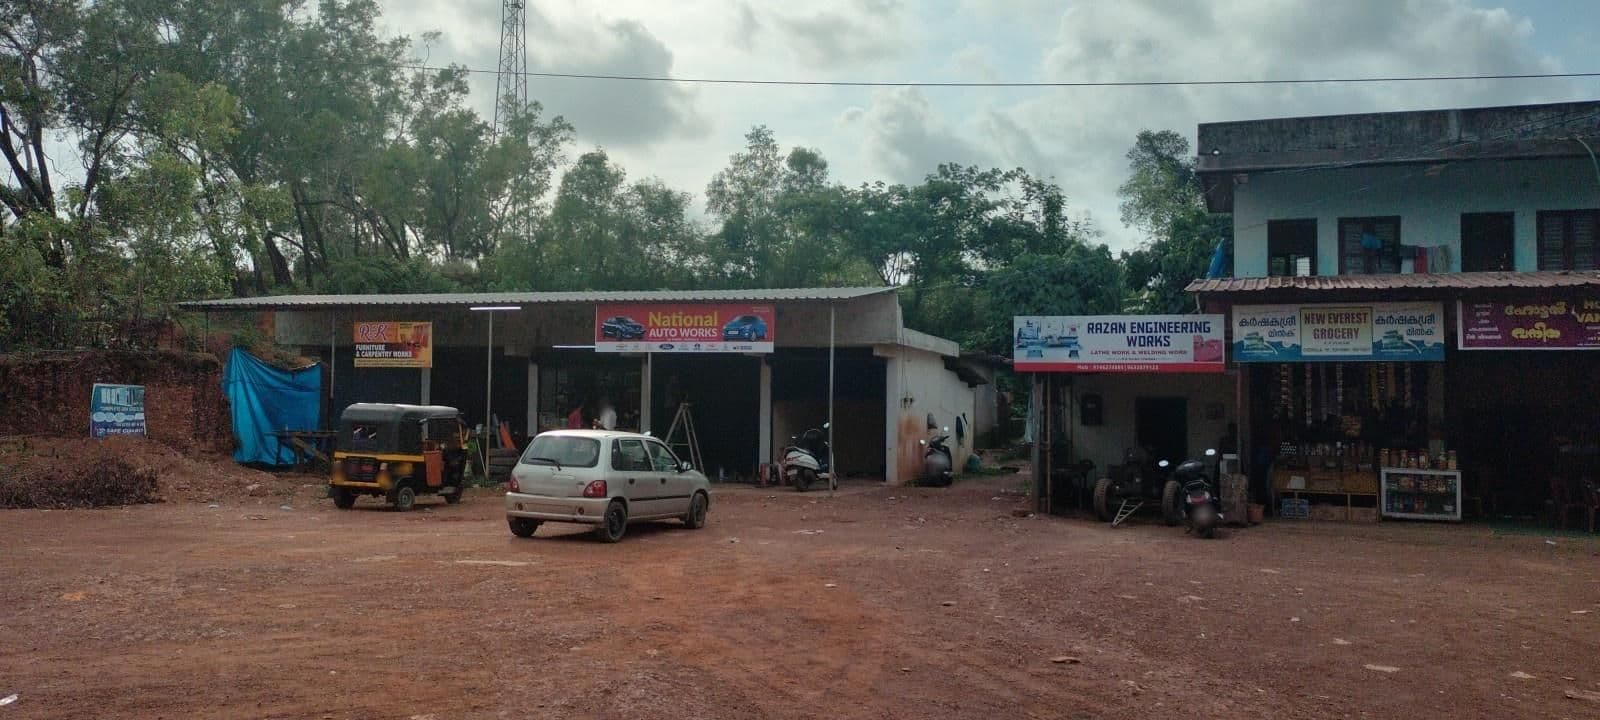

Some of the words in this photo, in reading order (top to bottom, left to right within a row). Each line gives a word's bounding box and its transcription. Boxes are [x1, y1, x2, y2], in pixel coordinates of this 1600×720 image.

[648, 311, 718, 327] National
[1304, 312, 1325, 324] NEW
[1328, 311, 1368, 324] EVEREST
[649, 328, 678, 337] AUTO
[679, 328, 718, 337] WORKS
[1087, 321, 1127, 334] RAZAN
[1130, 321, 1211, 334] ENGINEERING
[1313, 327, 1360, 340] GROCERY
[1126, 335, 1171, 347] WORKS
